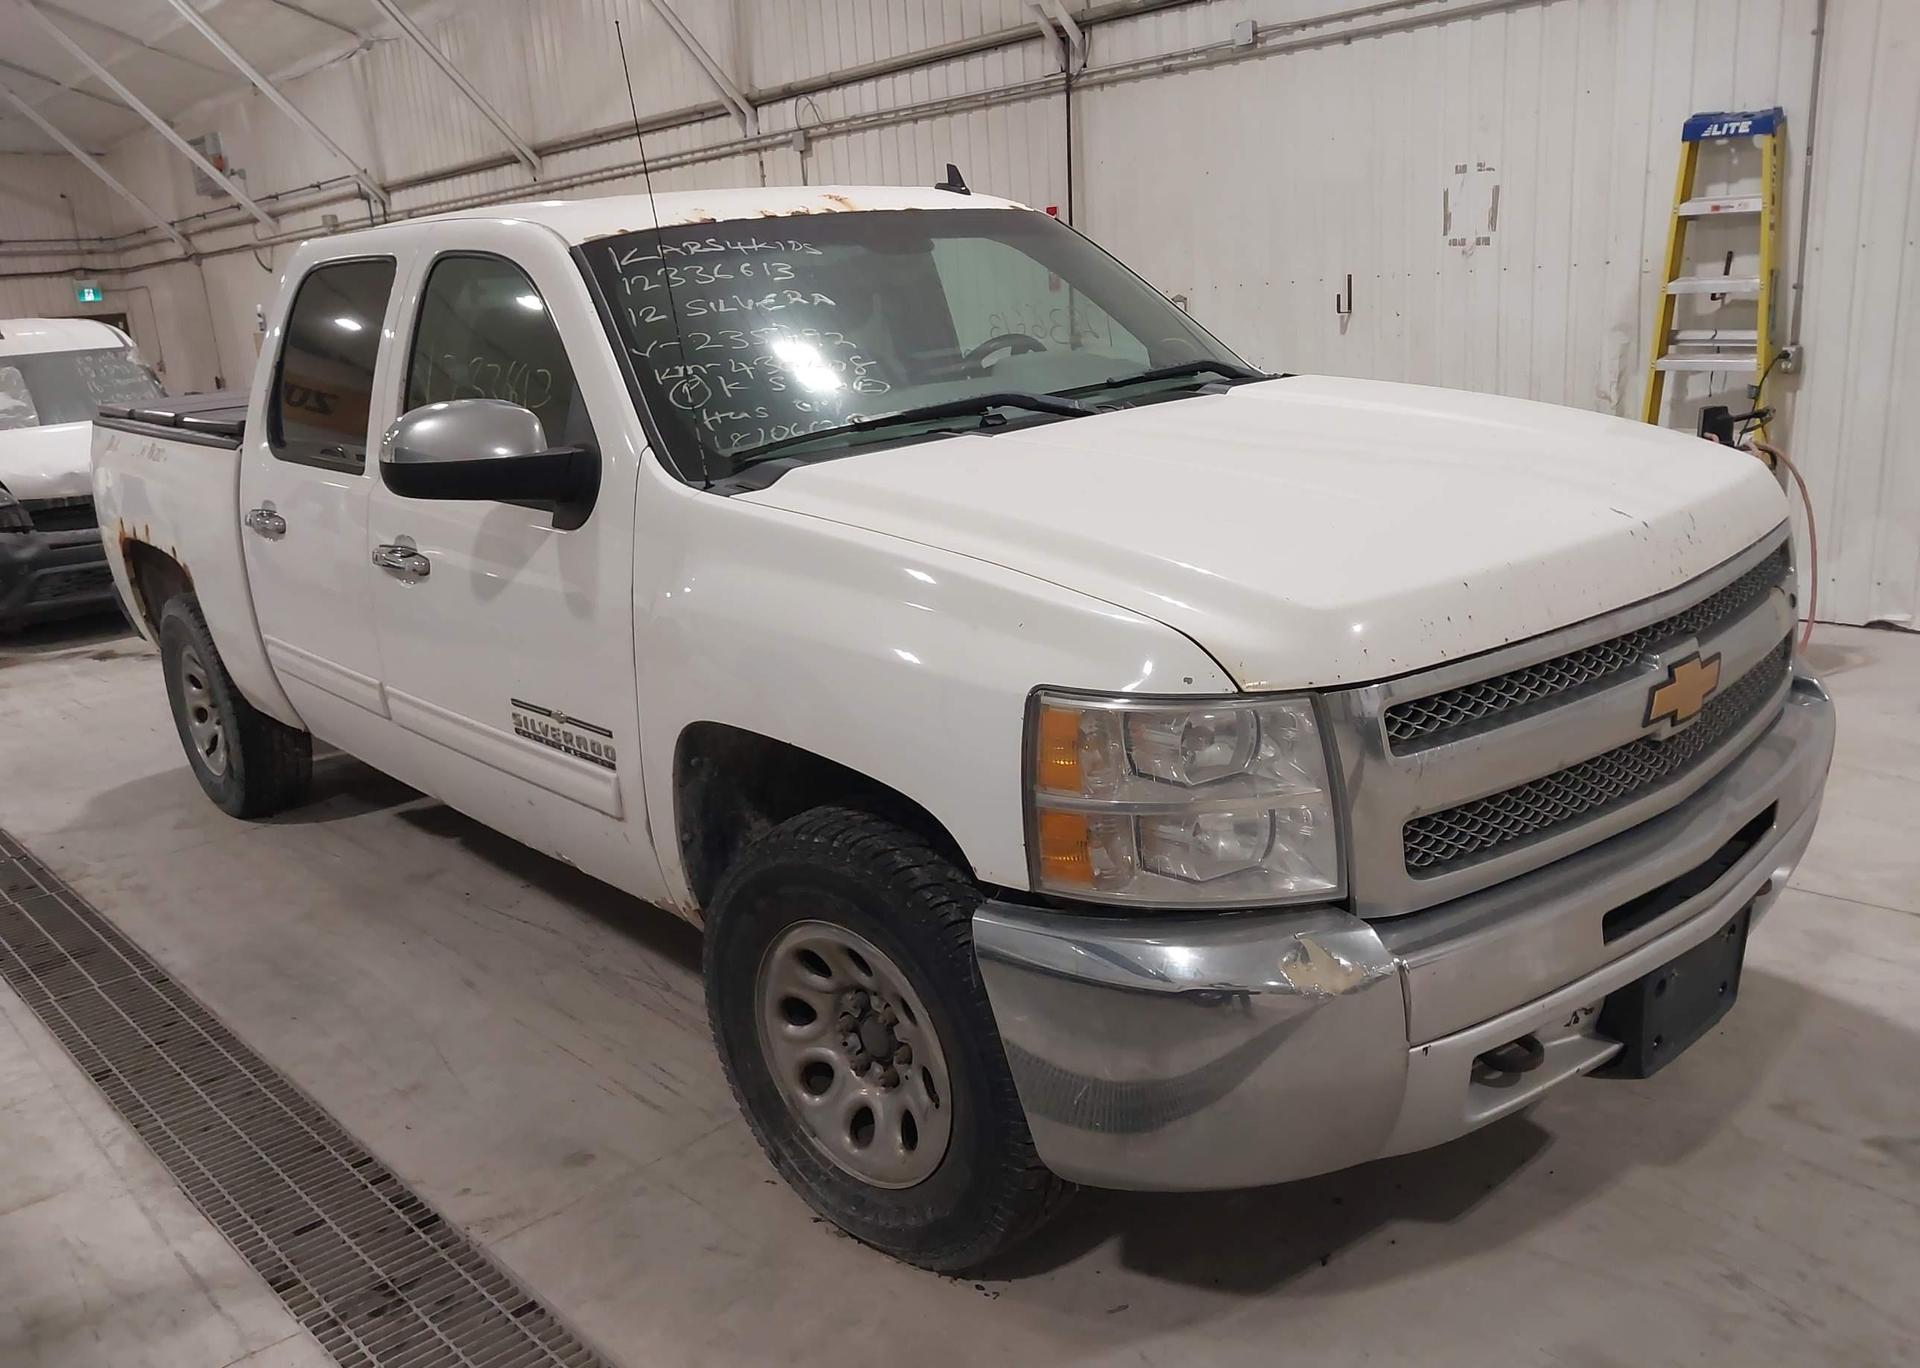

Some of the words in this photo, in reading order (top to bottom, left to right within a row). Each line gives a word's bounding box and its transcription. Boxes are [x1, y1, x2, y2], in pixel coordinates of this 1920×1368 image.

[609, 238, 823, 274] KARS4KIDS
[622, 262, 795, 295] 12336613
[628, 306, 668, 327] 12
[511, 711, 617, 763] SILVERADO
